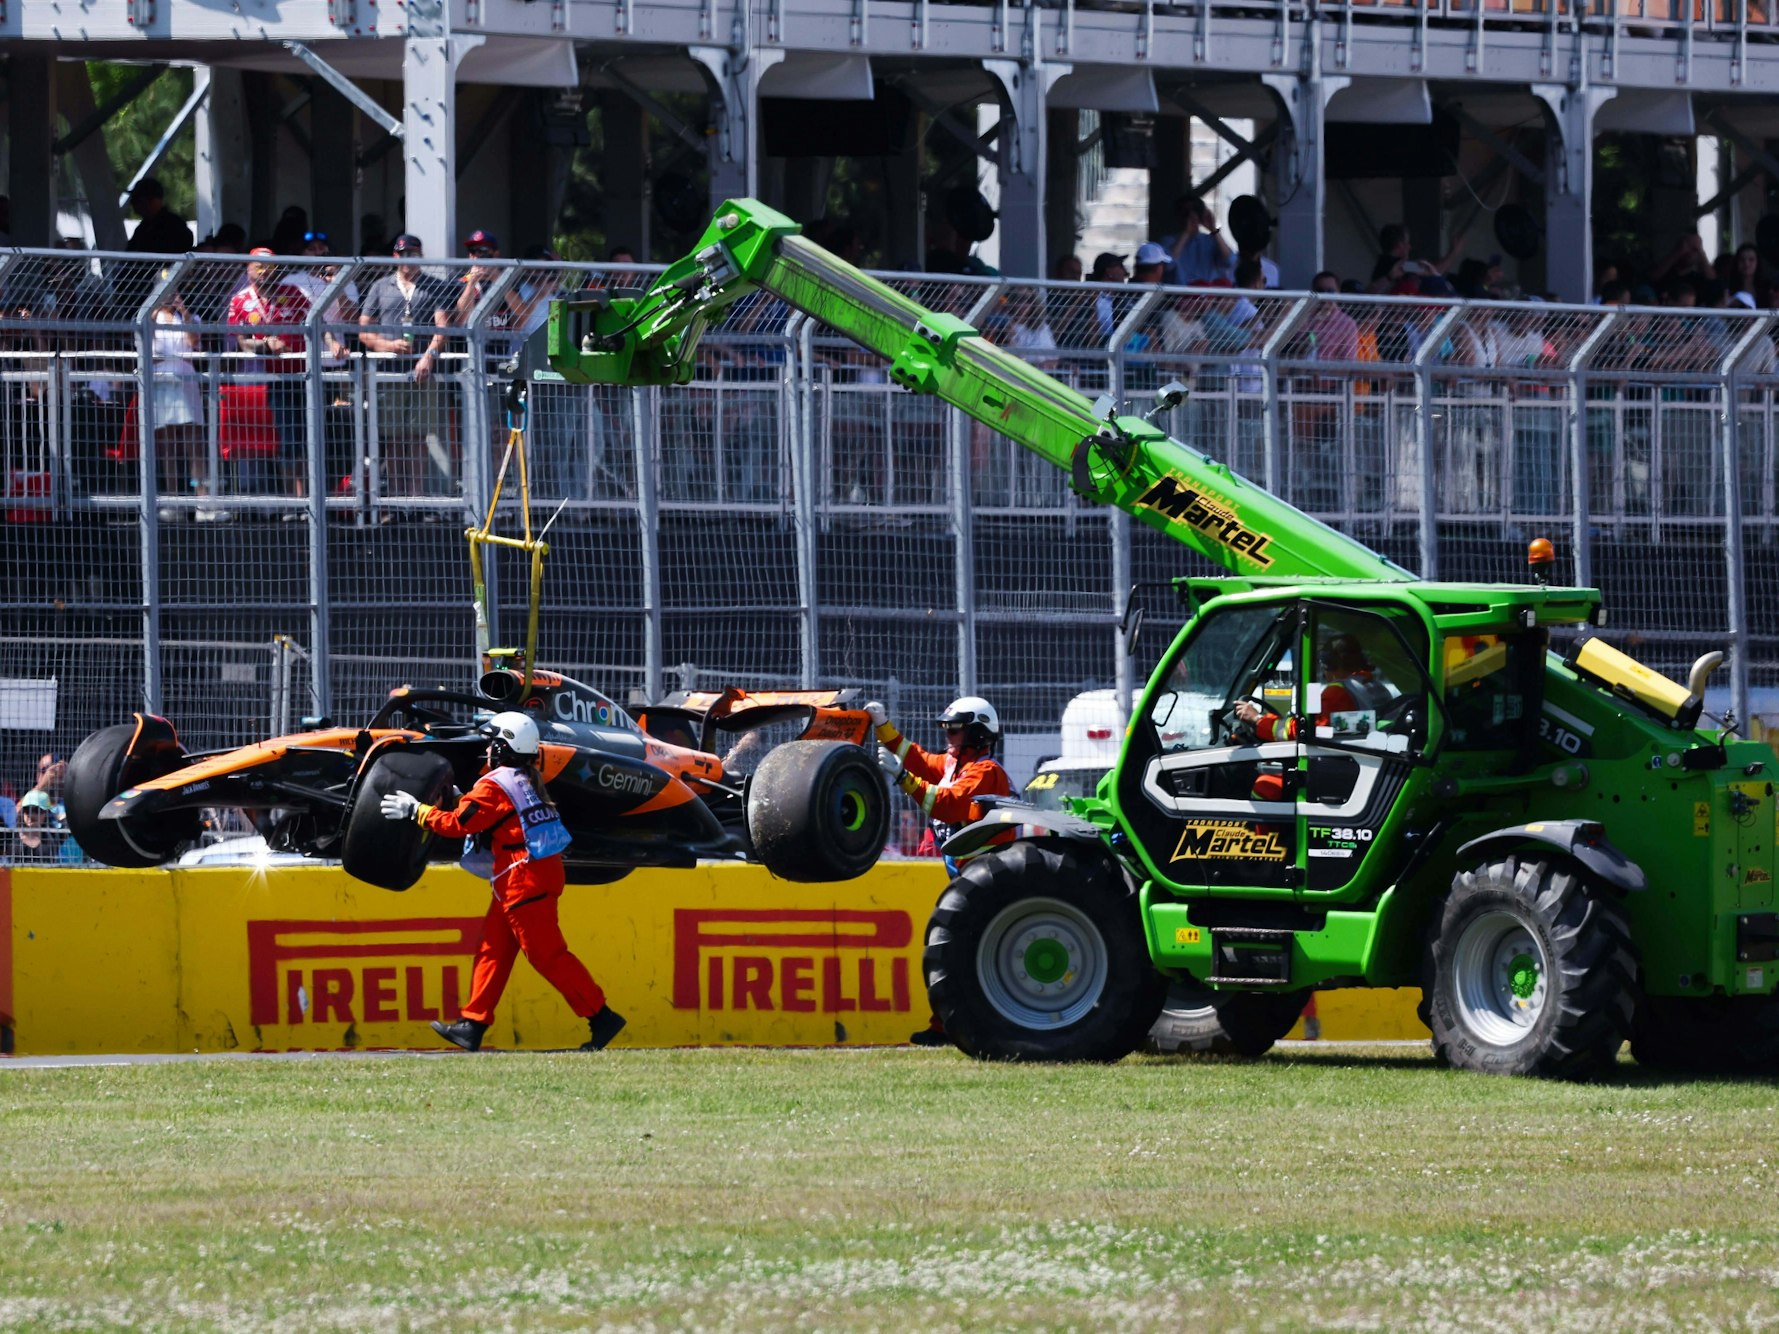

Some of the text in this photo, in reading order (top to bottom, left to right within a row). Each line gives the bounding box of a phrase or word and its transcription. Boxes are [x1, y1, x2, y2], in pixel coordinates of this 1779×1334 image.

[1197, 496, 1234, 520] Claude
[598, 763, 654, 797] Gemini
[1187, 819, 1248, 827] TRANSPORT
[1215, 829, 1246, 838] Claude
[247, 917, 484, 1026] PIRELL
[673, 908, 912, 1013] PIRELLI
